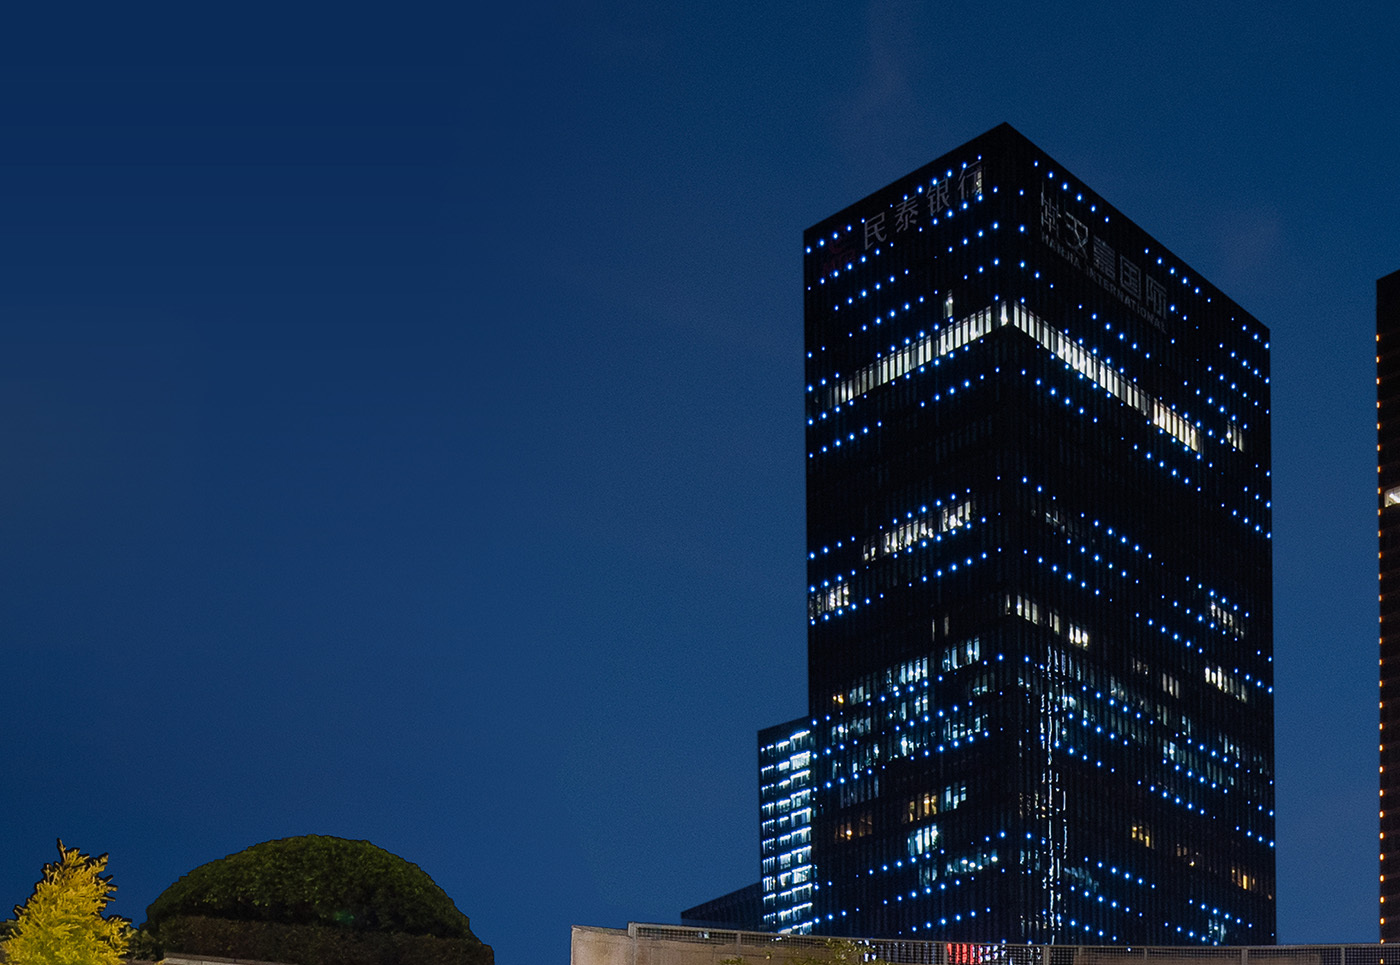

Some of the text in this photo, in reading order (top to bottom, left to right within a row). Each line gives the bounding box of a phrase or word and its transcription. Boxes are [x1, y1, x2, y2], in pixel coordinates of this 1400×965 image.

[862, 160, 984, 250] 民泰银行
[1086, 264, 1168, 335] INTERNATIONAL
